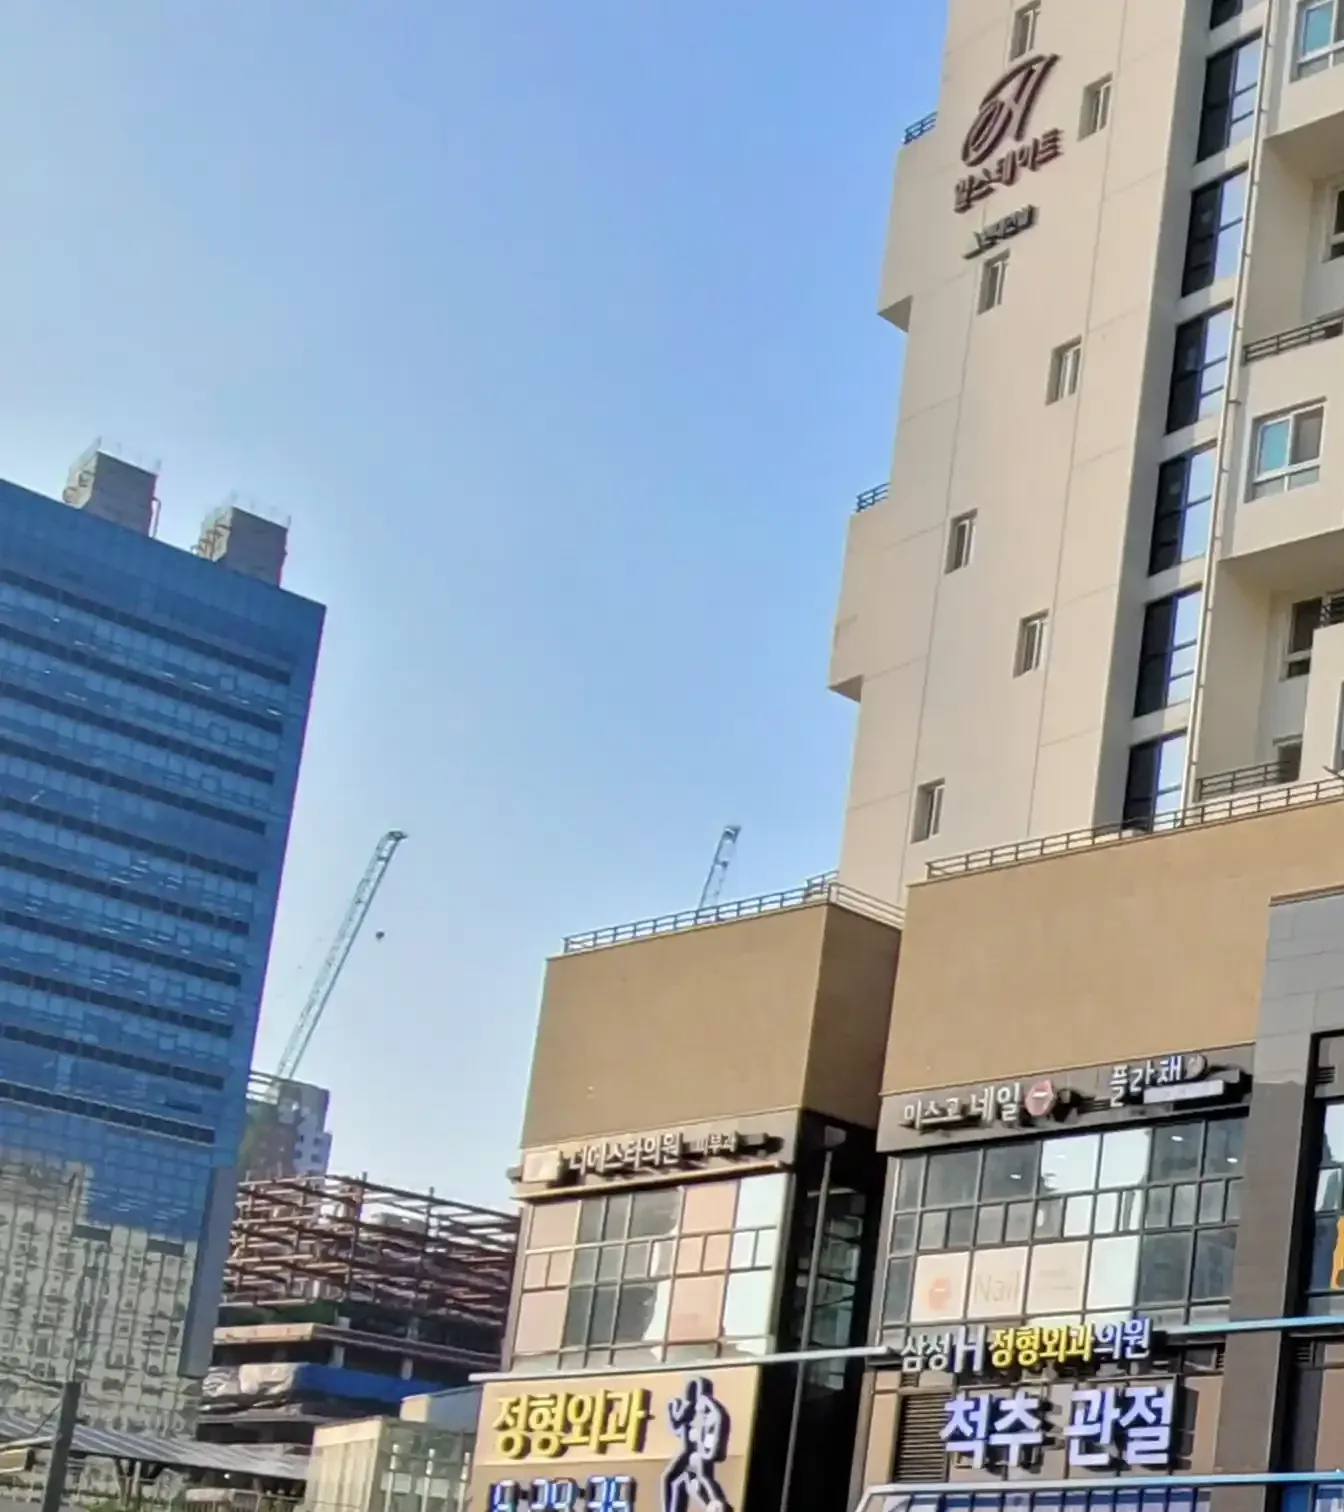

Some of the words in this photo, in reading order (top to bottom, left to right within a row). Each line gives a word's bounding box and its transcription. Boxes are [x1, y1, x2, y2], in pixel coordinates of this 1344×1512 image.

[970, 1082, 1021, 1123] 네일
[493, 1388, 645, 1458] 정형외과
[939, 1391, 1044, 1470] 척추
[1064, 1386, 1173, 1467] 관절
